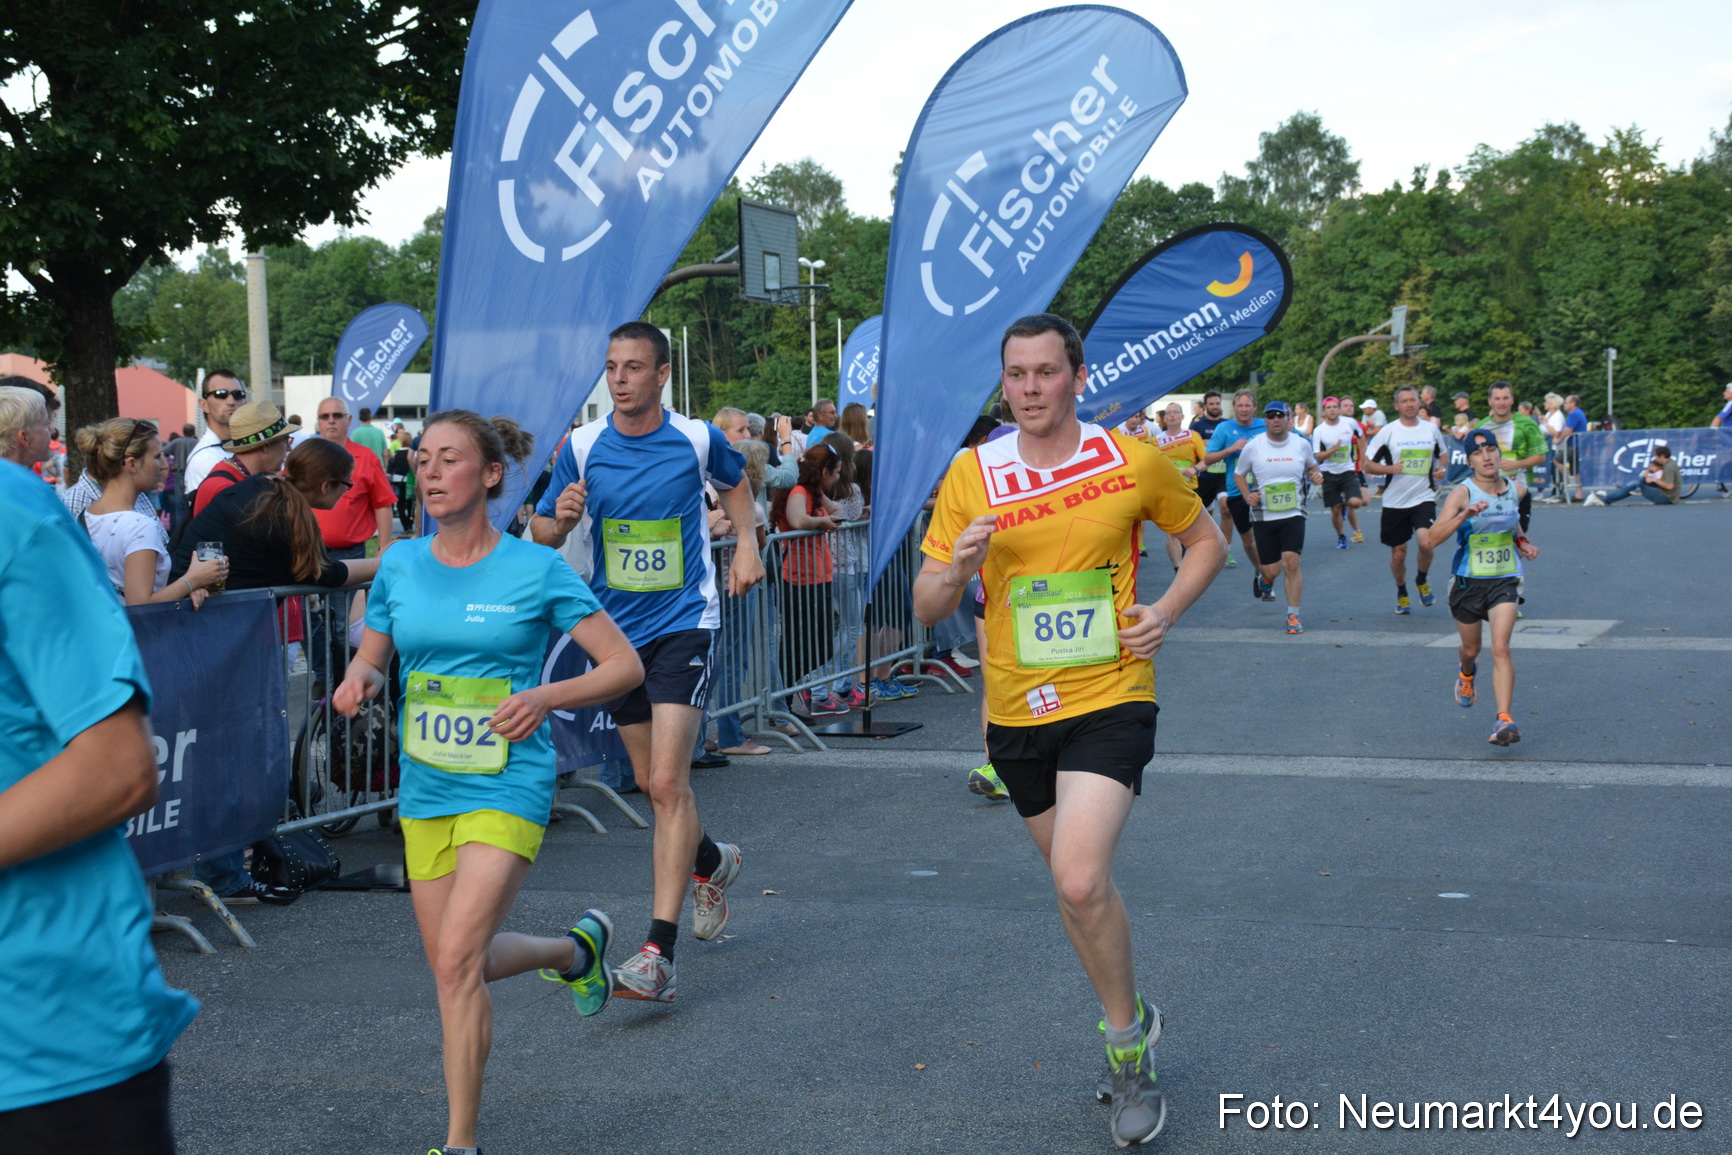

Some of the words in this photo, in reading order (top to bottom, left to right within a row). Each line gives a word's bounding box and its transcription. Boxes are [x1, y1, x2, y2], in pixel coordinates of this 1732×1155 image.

[637, 0, 786, 202] AUTOMOB
[958, 54, 1118, 279] Fischer
[1015, 95, 1138, 275] AUTOMOBILE
[1167, 332, 1205, 360] Druck
[1205, 319, 1230, 338] und
[1230, 289, 1277, 325] Medien
[354, 318, 408, 389] Fischer
[373, 331, 414, 389] AUTOMOBILE
[856, 345, 880, 385] Fisc
[1076, 302, 1222, 403] rischmann
[1406, 460, 1425, 469] 287
[993, 502, 1056, 533] MAX
[1063, 475, 1136, 509] BÖGL
[1272, 494, 1291, 504] 576
[618, 548, 667, 572] 788
[1476, 548, 1511, 564] 1330
[464, 614, 485, 622] Julia
[474, 604, 516, 613] PFLEIDERER
[1033, 608, 1095, 642] 867
[415, 711, 496, 747] 1092
